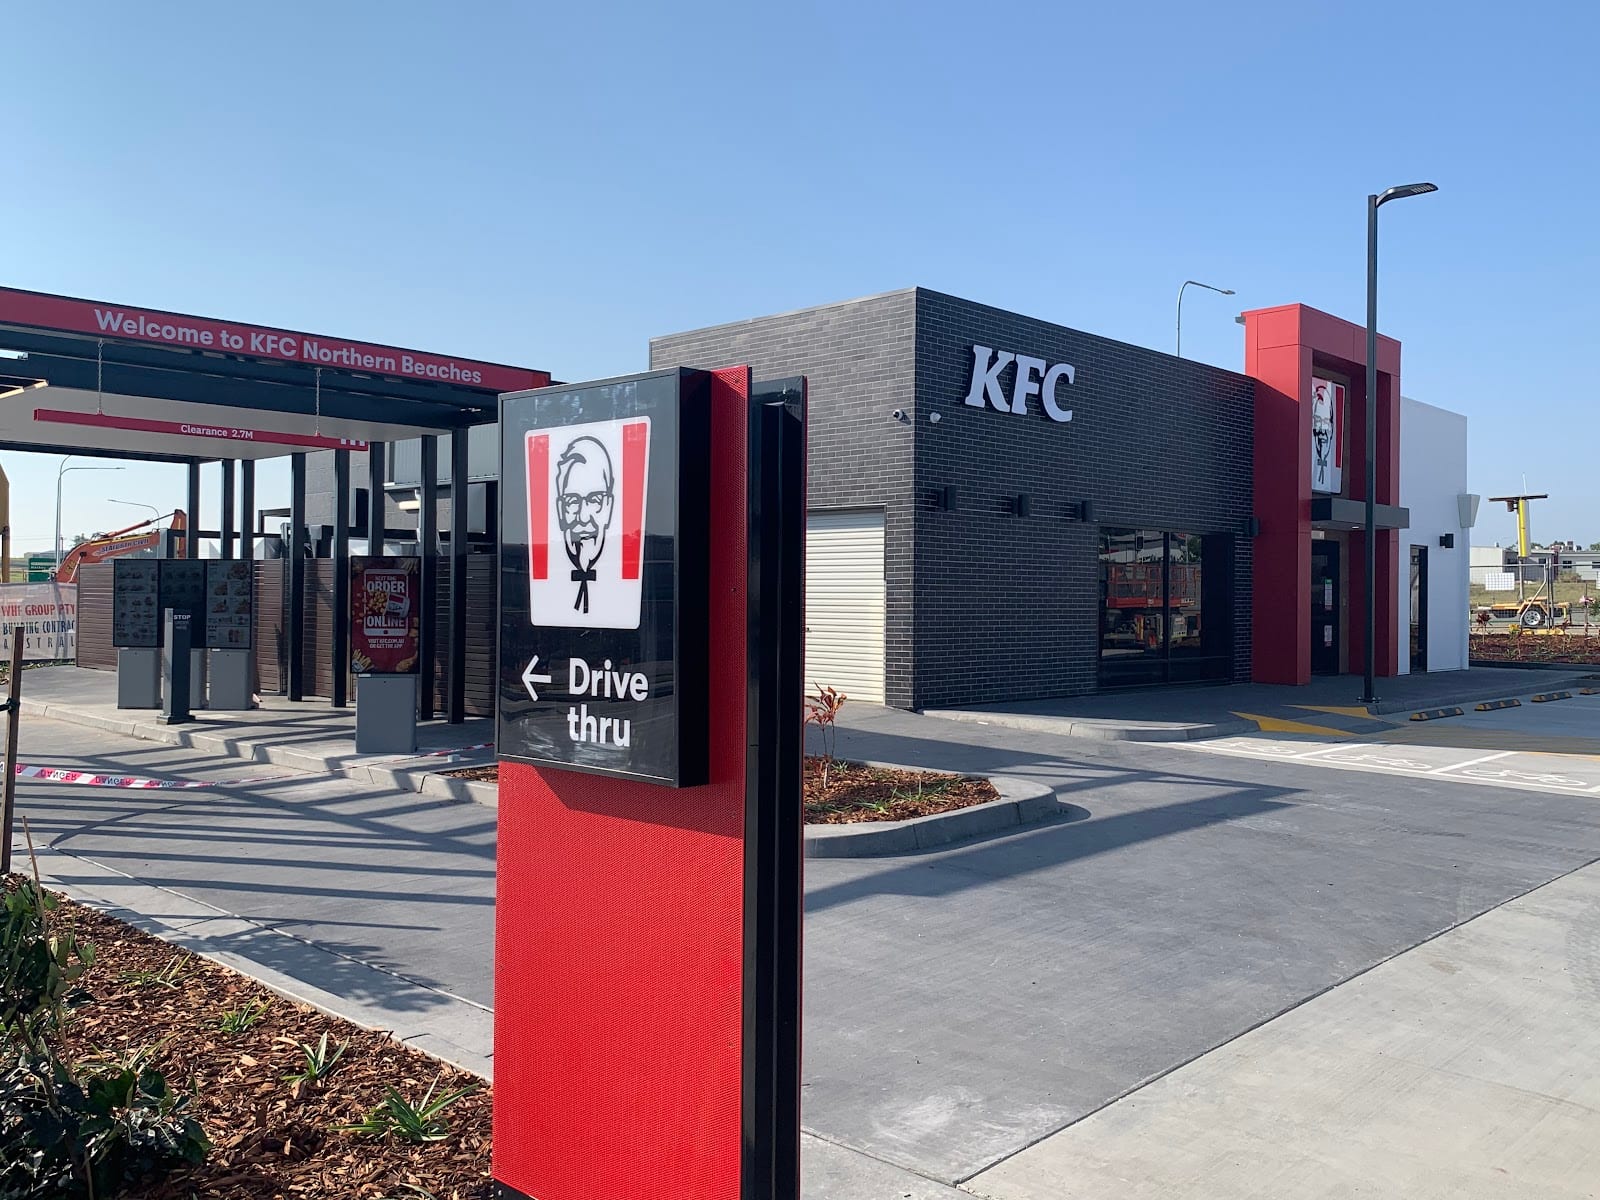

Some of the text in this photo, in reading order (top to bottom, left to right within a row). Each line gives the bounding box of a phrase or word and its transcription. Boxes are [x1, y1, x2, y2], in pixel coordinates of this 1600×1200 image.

[94, 308, 482, 384] Welcome to KFC Northern Beaches
[964, 344, 1076, 423] KFC
[180, 424, 254, 439] Clearance 2.7M
[367, 580, 405, 593] ORDER
[25, 604, 56, 616] GROUP
[58, 603, 75, 615] PTY
[366, 615, 405, 627] ONLINE
[569, 657, 649, 701] Drive
[567, 704, 631, 747] thru
